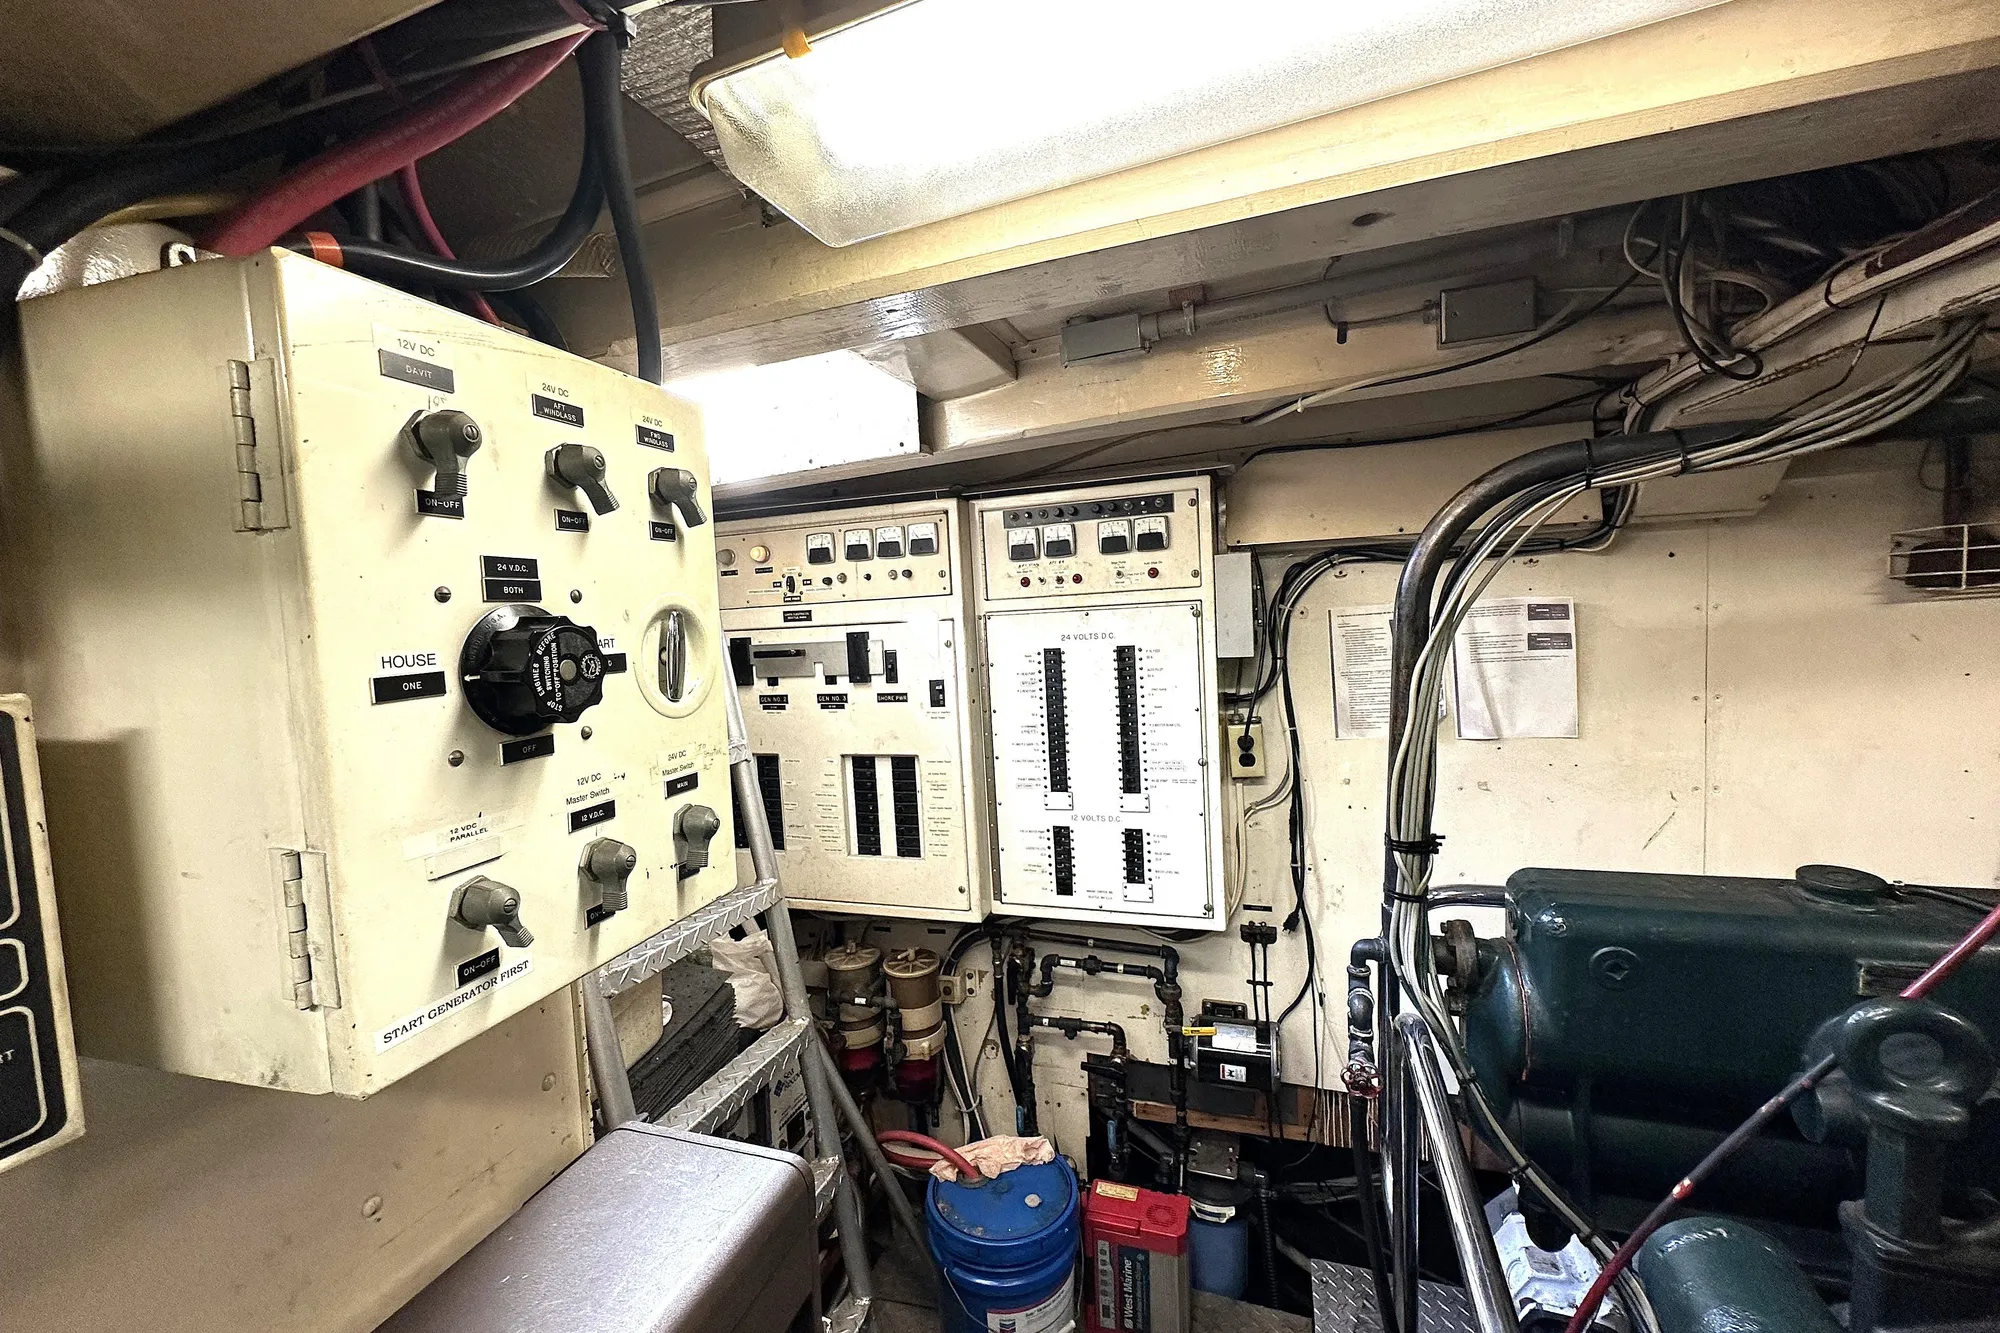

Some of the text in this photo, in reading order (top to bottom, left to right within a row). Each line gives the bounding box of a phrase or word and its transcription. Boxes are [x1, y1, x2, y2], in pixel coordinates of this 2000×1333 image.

[397, 338, 435, 357] 12V DC
[405, 364, 433, 379] DAVIT
[541, 382, 569, 398] 24V DC
[553, 402, 566, 412] AFT
[543, 407, 577, 422] WINDLASS
[642, 415, 663, 427] 24V DC
[650, 431, 661, 440] FWD
[643, 436, 669, 448] WINDLASS
[425, 497, 461, 509] ON-OFF
[561, 515, 588, 525] ON-OFF
[655, 526, 674, 536] ON-OFF
[496, 563, 529, 573] 24 V.D.C.
[503, 585, 524, 595] BOTH
[1060, 634, 1072, 642] 24
[1073, 632, 1100, 641] VOLTS
[597, 638, 615, 649] ART
[381, 653, 437, 669] HOUSE
[532, 631, 563, 712] STOP ENGINES BEFORE
[543, 656, 553, 691] SWITCHING
[402, 681, 423, 691] ONE
[522, 744, 537, 755] OFF
[668, 750, 686, 761] 24V DC
[662, 762, 694, 776] Master Switch
[576, 772, 602, 786] 12V DC
[566, 786, 611, 806] Master Switch
[581, 814, 588, 822] 12
[1071, 814, 1123, 823] 12 VOLTS D.C.
[460, 822, 477, 833] VDC
[450, 827, 489, 842] PARALLEL
[463, 954, 497, 976] ON-OFF
[383, 959, 530, 1044] START GENERATOR FIRST
[1122, 1259, 1134, 1318] West Marine
